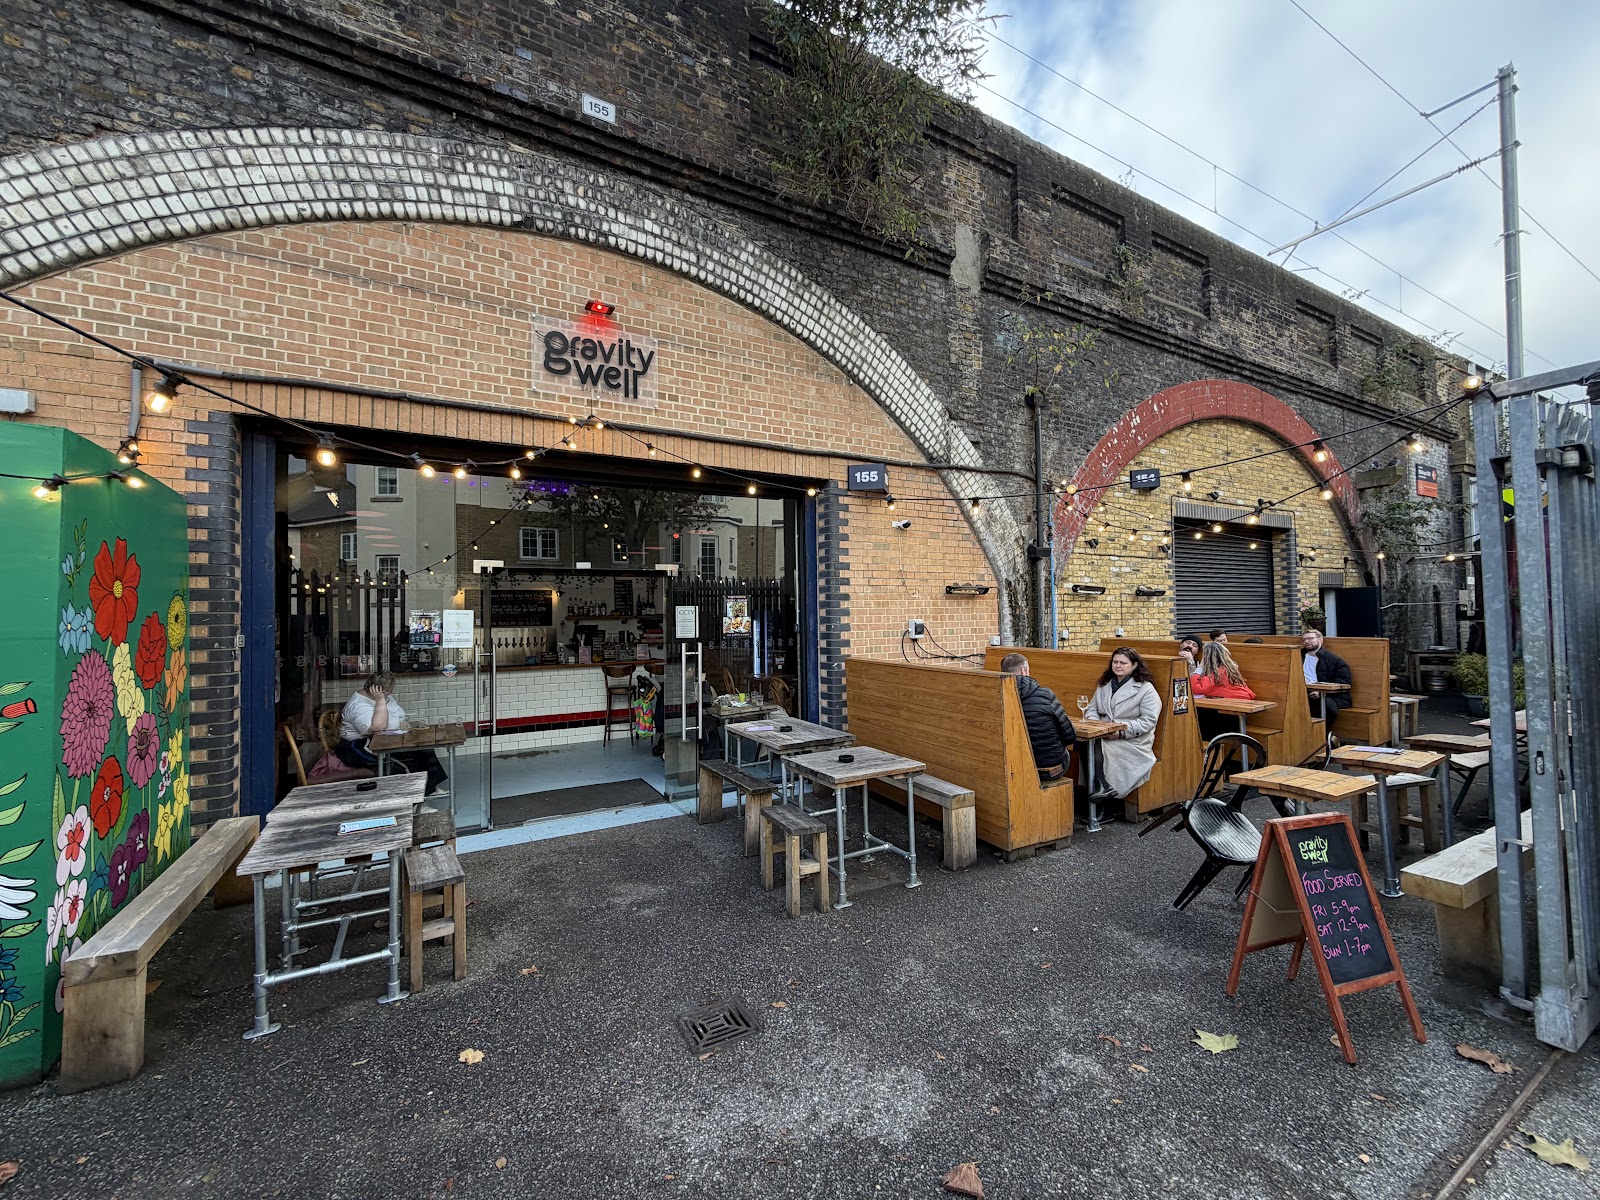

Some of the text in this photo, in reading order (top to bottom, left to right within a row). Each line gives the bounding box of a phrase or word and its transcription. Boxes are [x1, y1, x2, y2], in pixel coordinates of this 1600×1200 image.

[588, 101, 609, 117] 155
[543, 330, 655, 376] gravity
[573, 359, 639, 399] well
[580, 386, 610, 396] BREWING
[854, 470, 879, 483] 155
[1135, 473, 1157, 483] 154
[1298, 835, 1328, 860] gravity
[1302, 869, 1363, 896] FOOD SERVED
[1312, 899, 1360, 920] FRI 5-9pm
[1317, 915, 1370, 938] SAT 12-9pm
[1322, 936, 1372, 960] SUN 1-7pm
